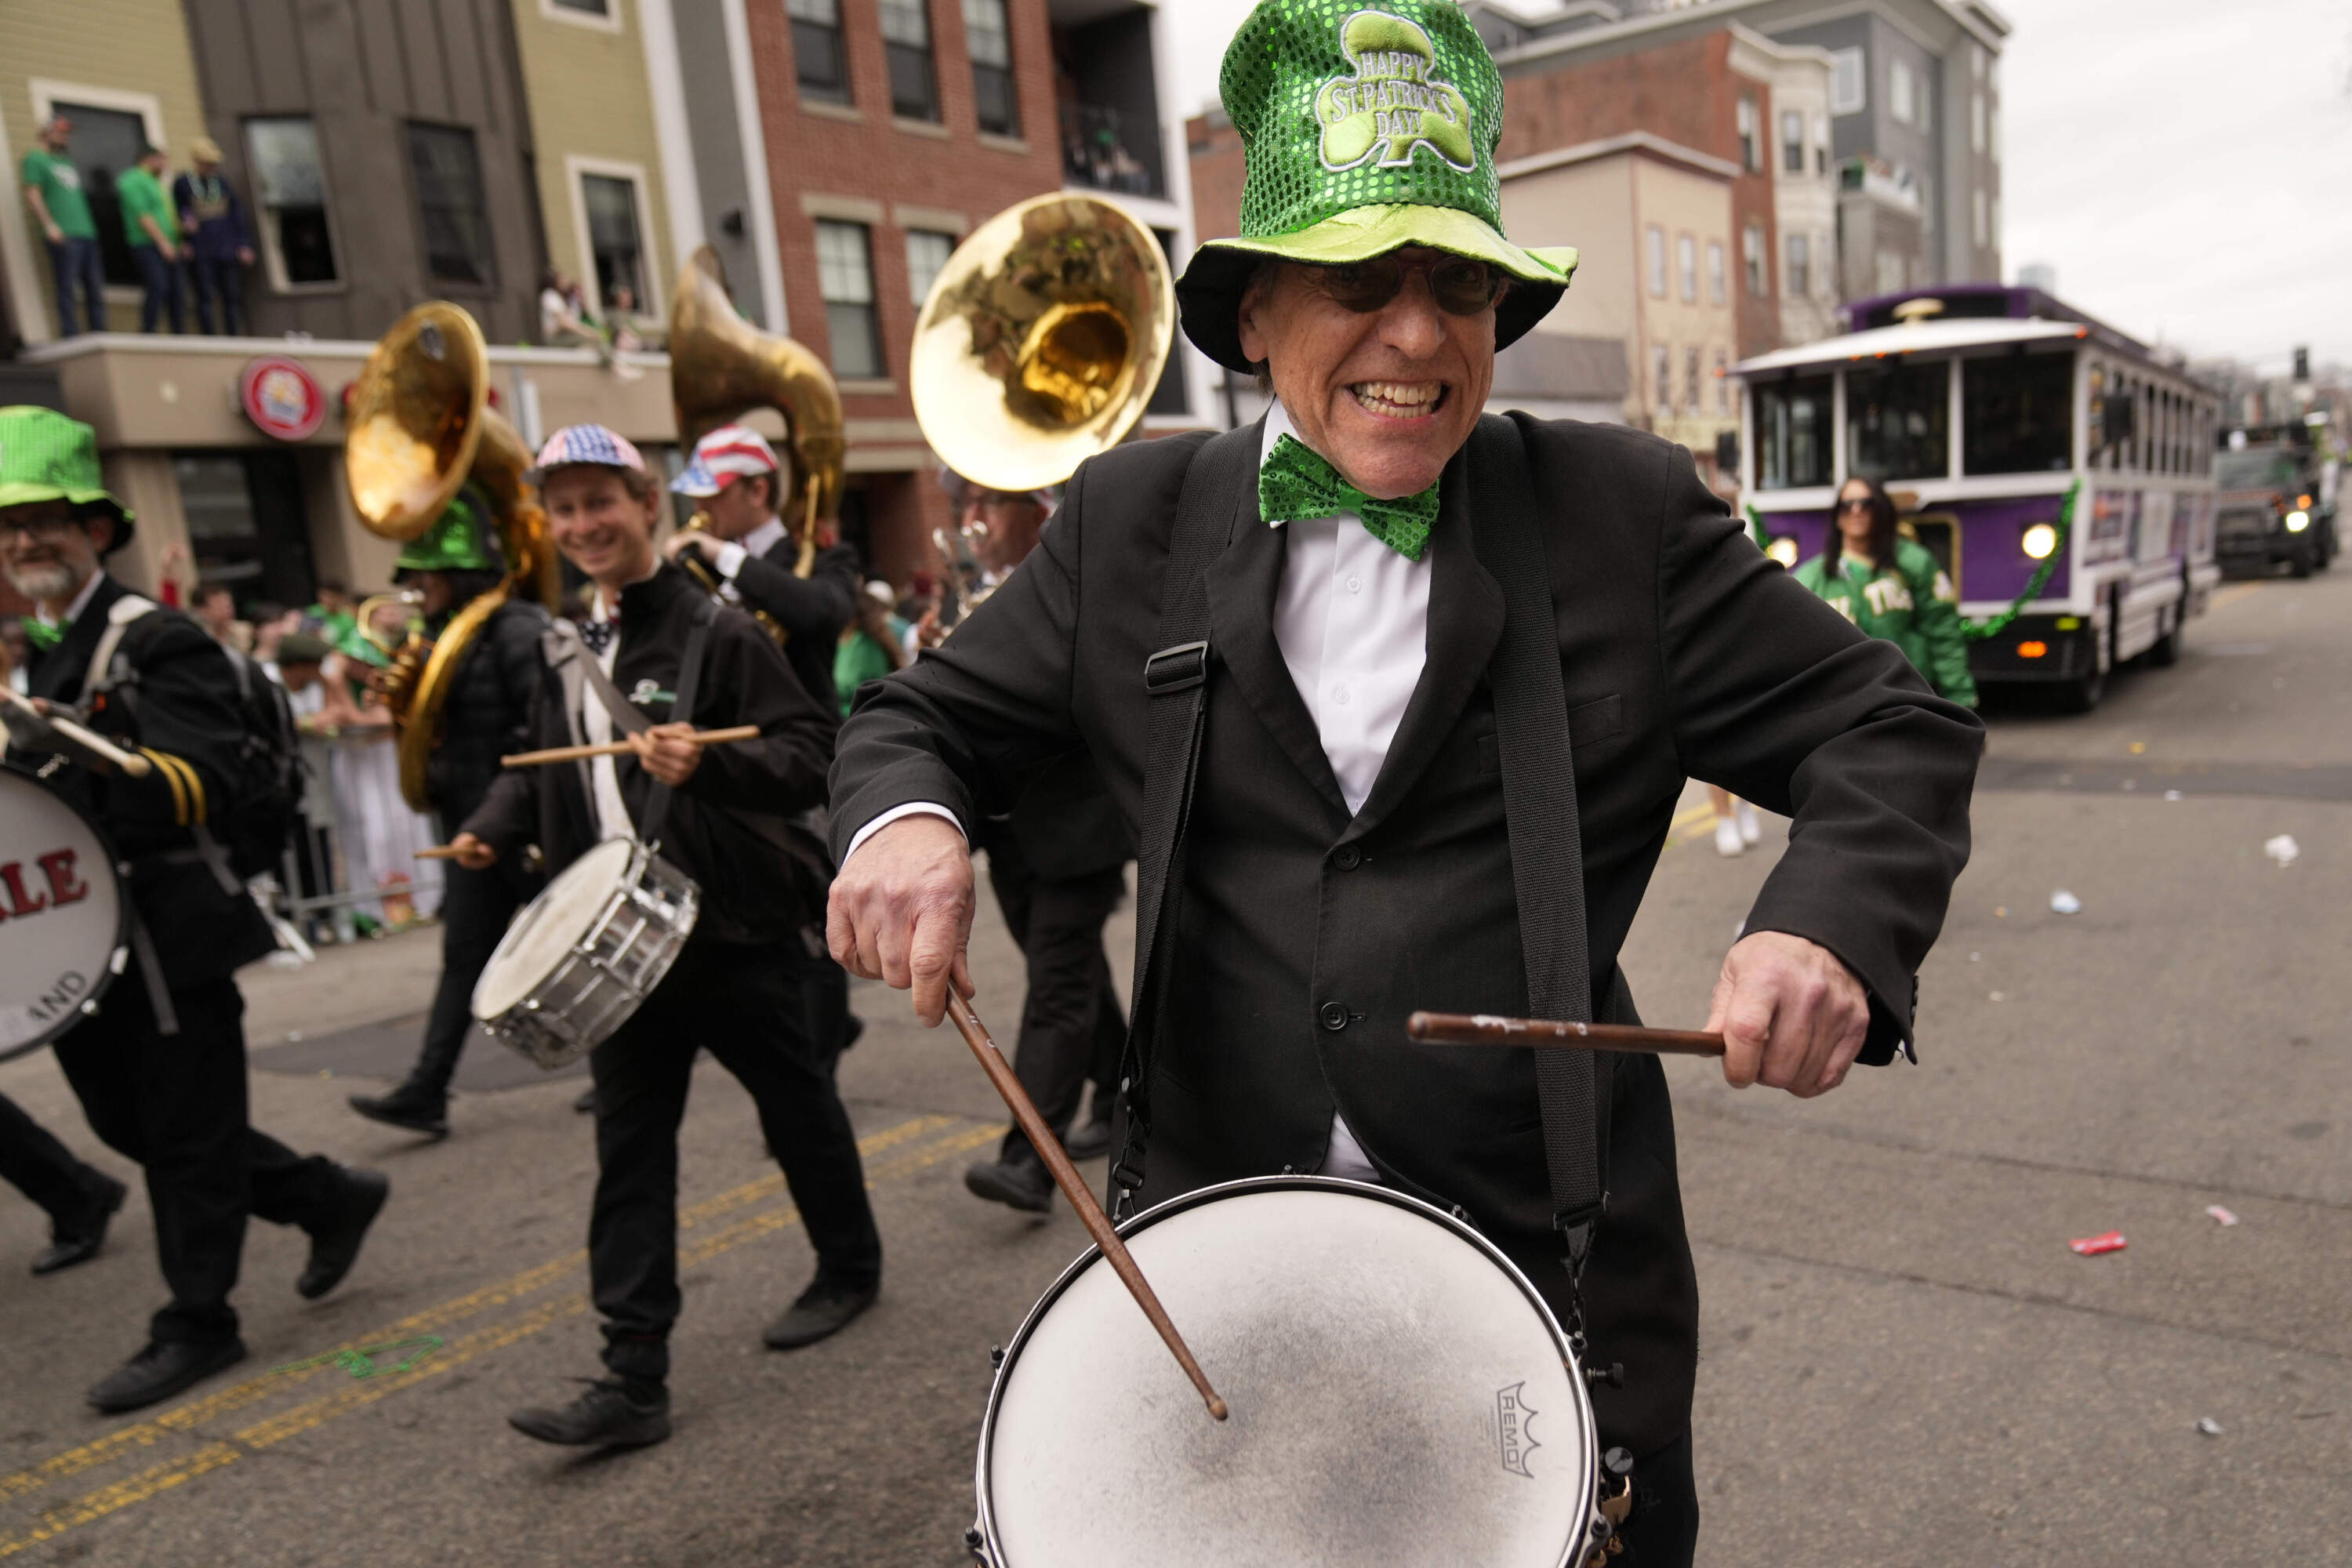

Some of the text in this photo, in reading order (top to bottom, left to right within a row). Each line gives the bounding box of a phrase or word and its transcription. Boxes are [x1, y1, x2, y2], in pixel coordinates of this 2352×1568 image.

[1361, 51, 1425, 79] HAPPY
[0, 849, 88, 923] LE
[1503, 1396, 1519, 1464] REMO
